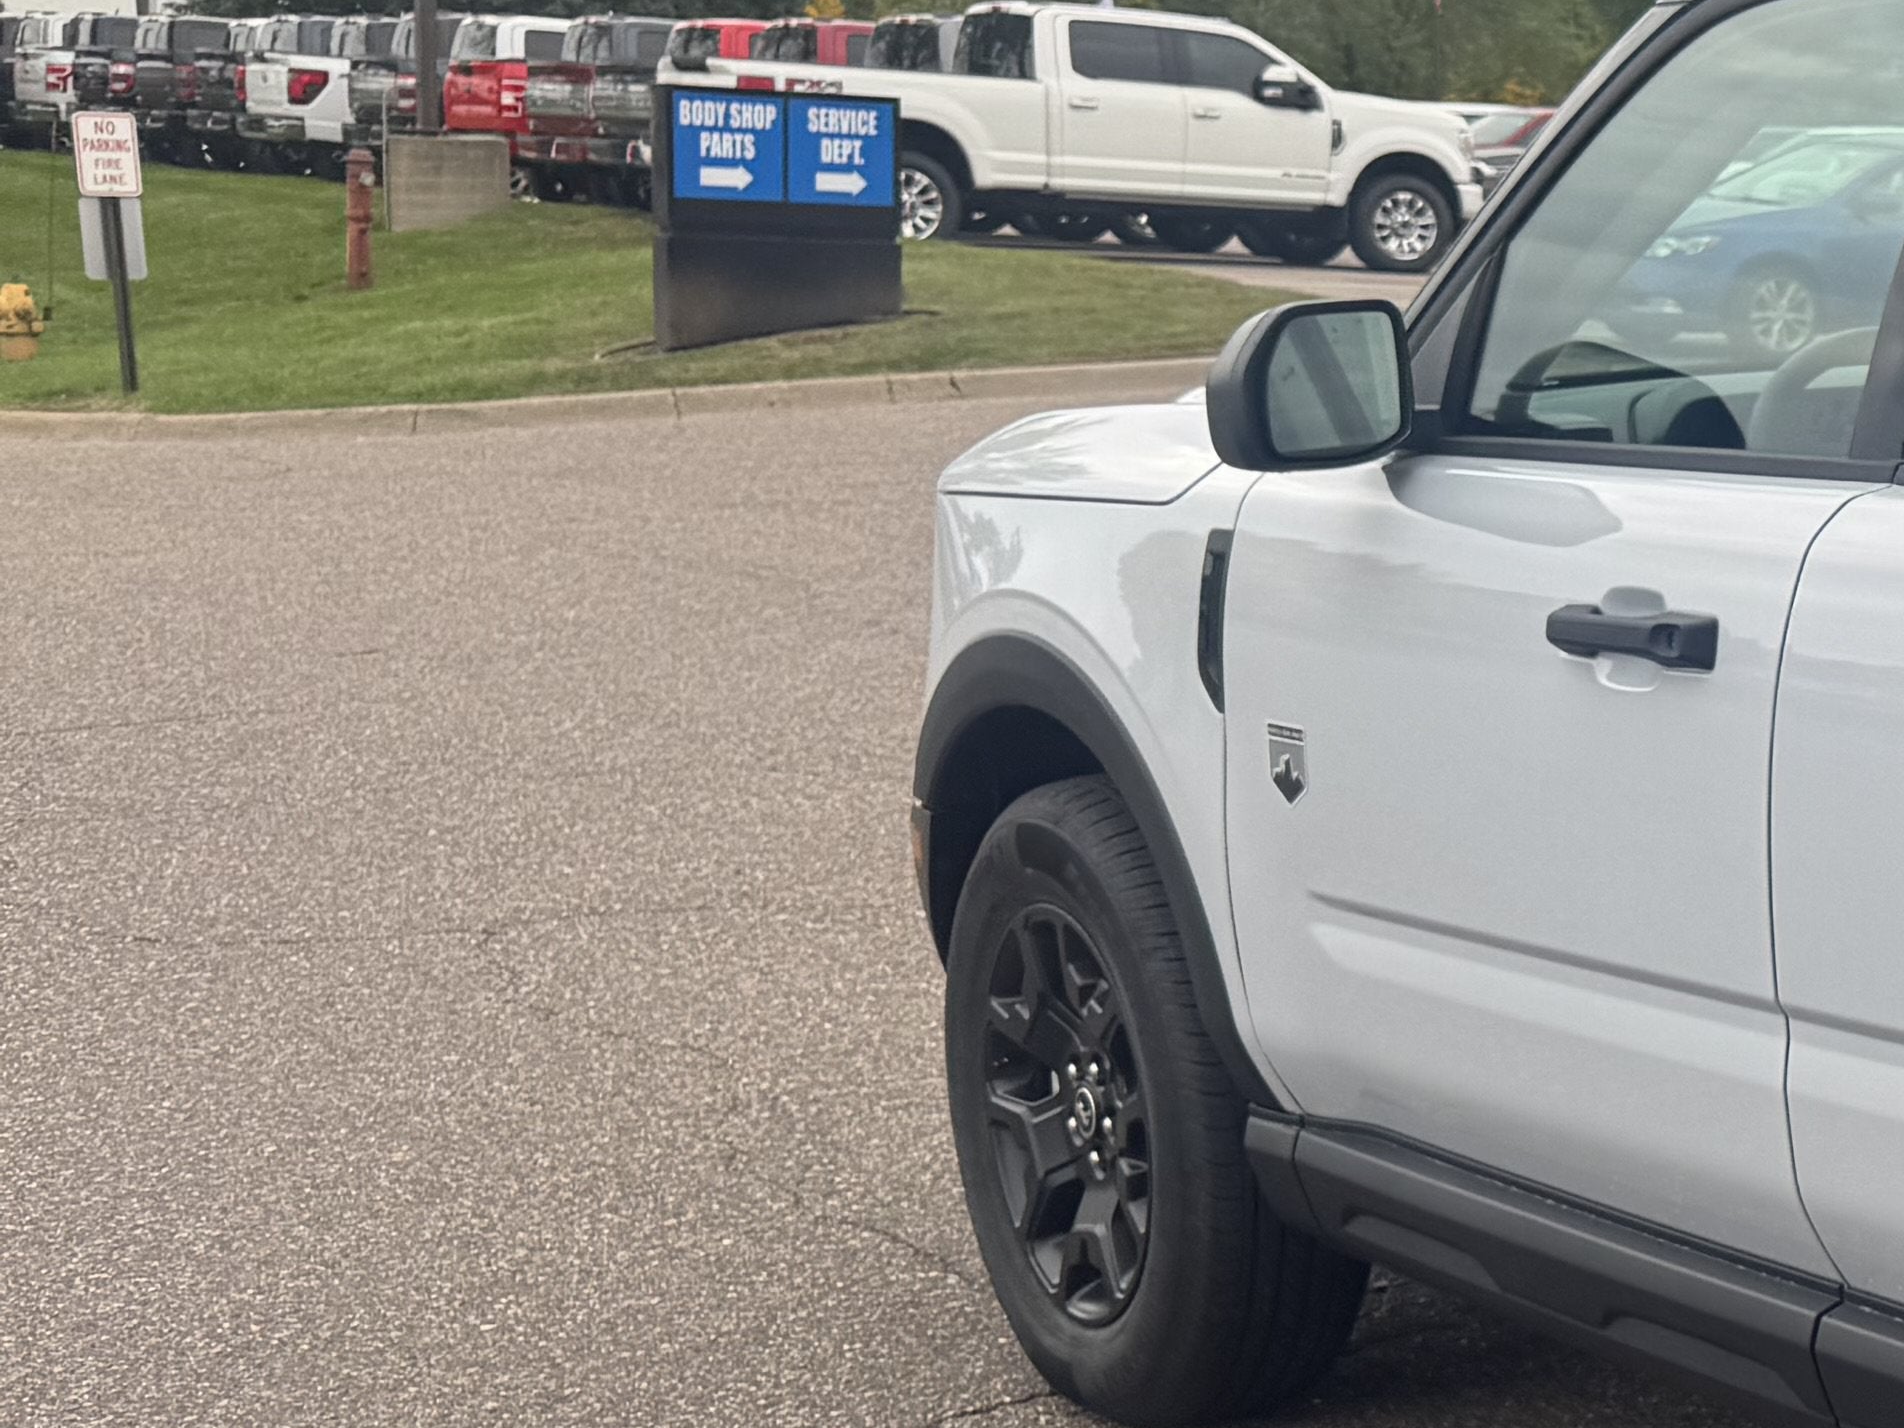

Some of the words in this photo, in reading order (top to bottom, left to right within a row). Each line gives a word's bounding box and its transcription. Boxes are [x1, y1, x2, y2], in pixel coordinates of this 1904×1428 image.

[679, 99, 726, 128] BODY
[730, 102, 777, 130] SHOP
[808, 107, 878, 136] SERVICE
[94, 120, 115, 135] NO
[82, 138, 131, 152] PARKING
[700, 132, 756, 160] PARTS
[821, 138, 864, 166] DEPT.
[94, 158, 122, 170] FIRE
[94, 174, 128, 186] LANE
